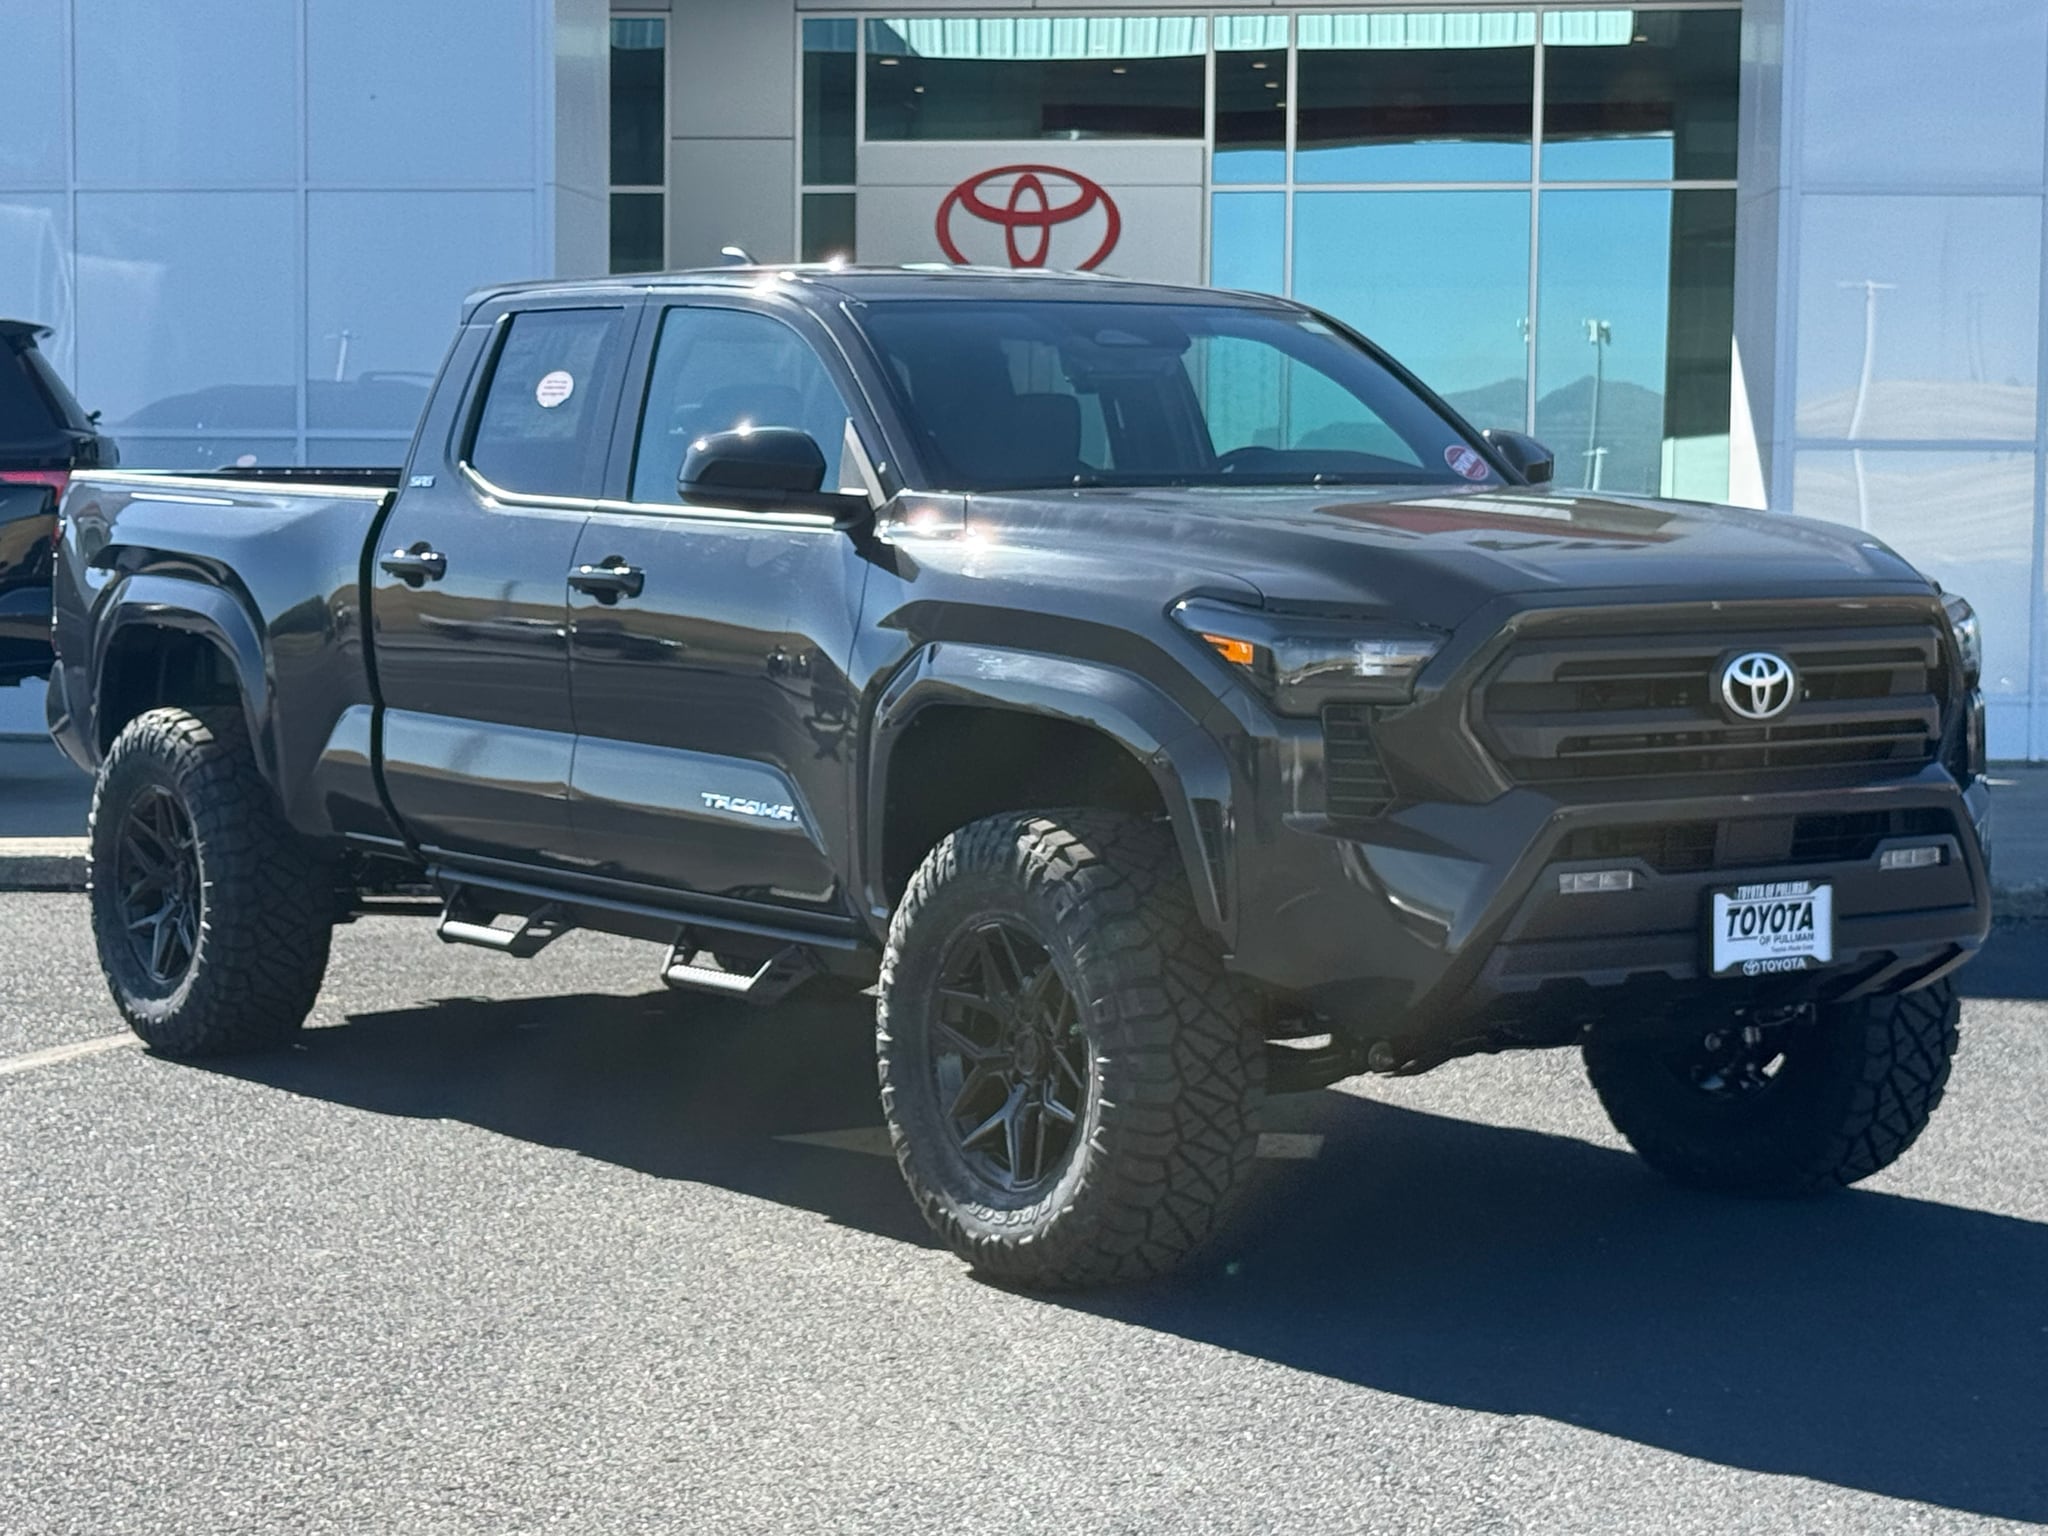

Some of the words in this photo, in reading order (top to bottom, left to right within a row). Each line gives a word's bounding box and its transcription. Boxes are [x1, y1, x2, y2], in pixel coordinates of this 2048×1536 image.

[701, 792, 796, 821] TACOMA
[1726, 902, 1813, 936] TOYOTA
[1759, 937, 1771, 945] OF
[1773, 932, 1814, 944] PULLMAN
[1760, 958, 1807, 972] TOYOTA
